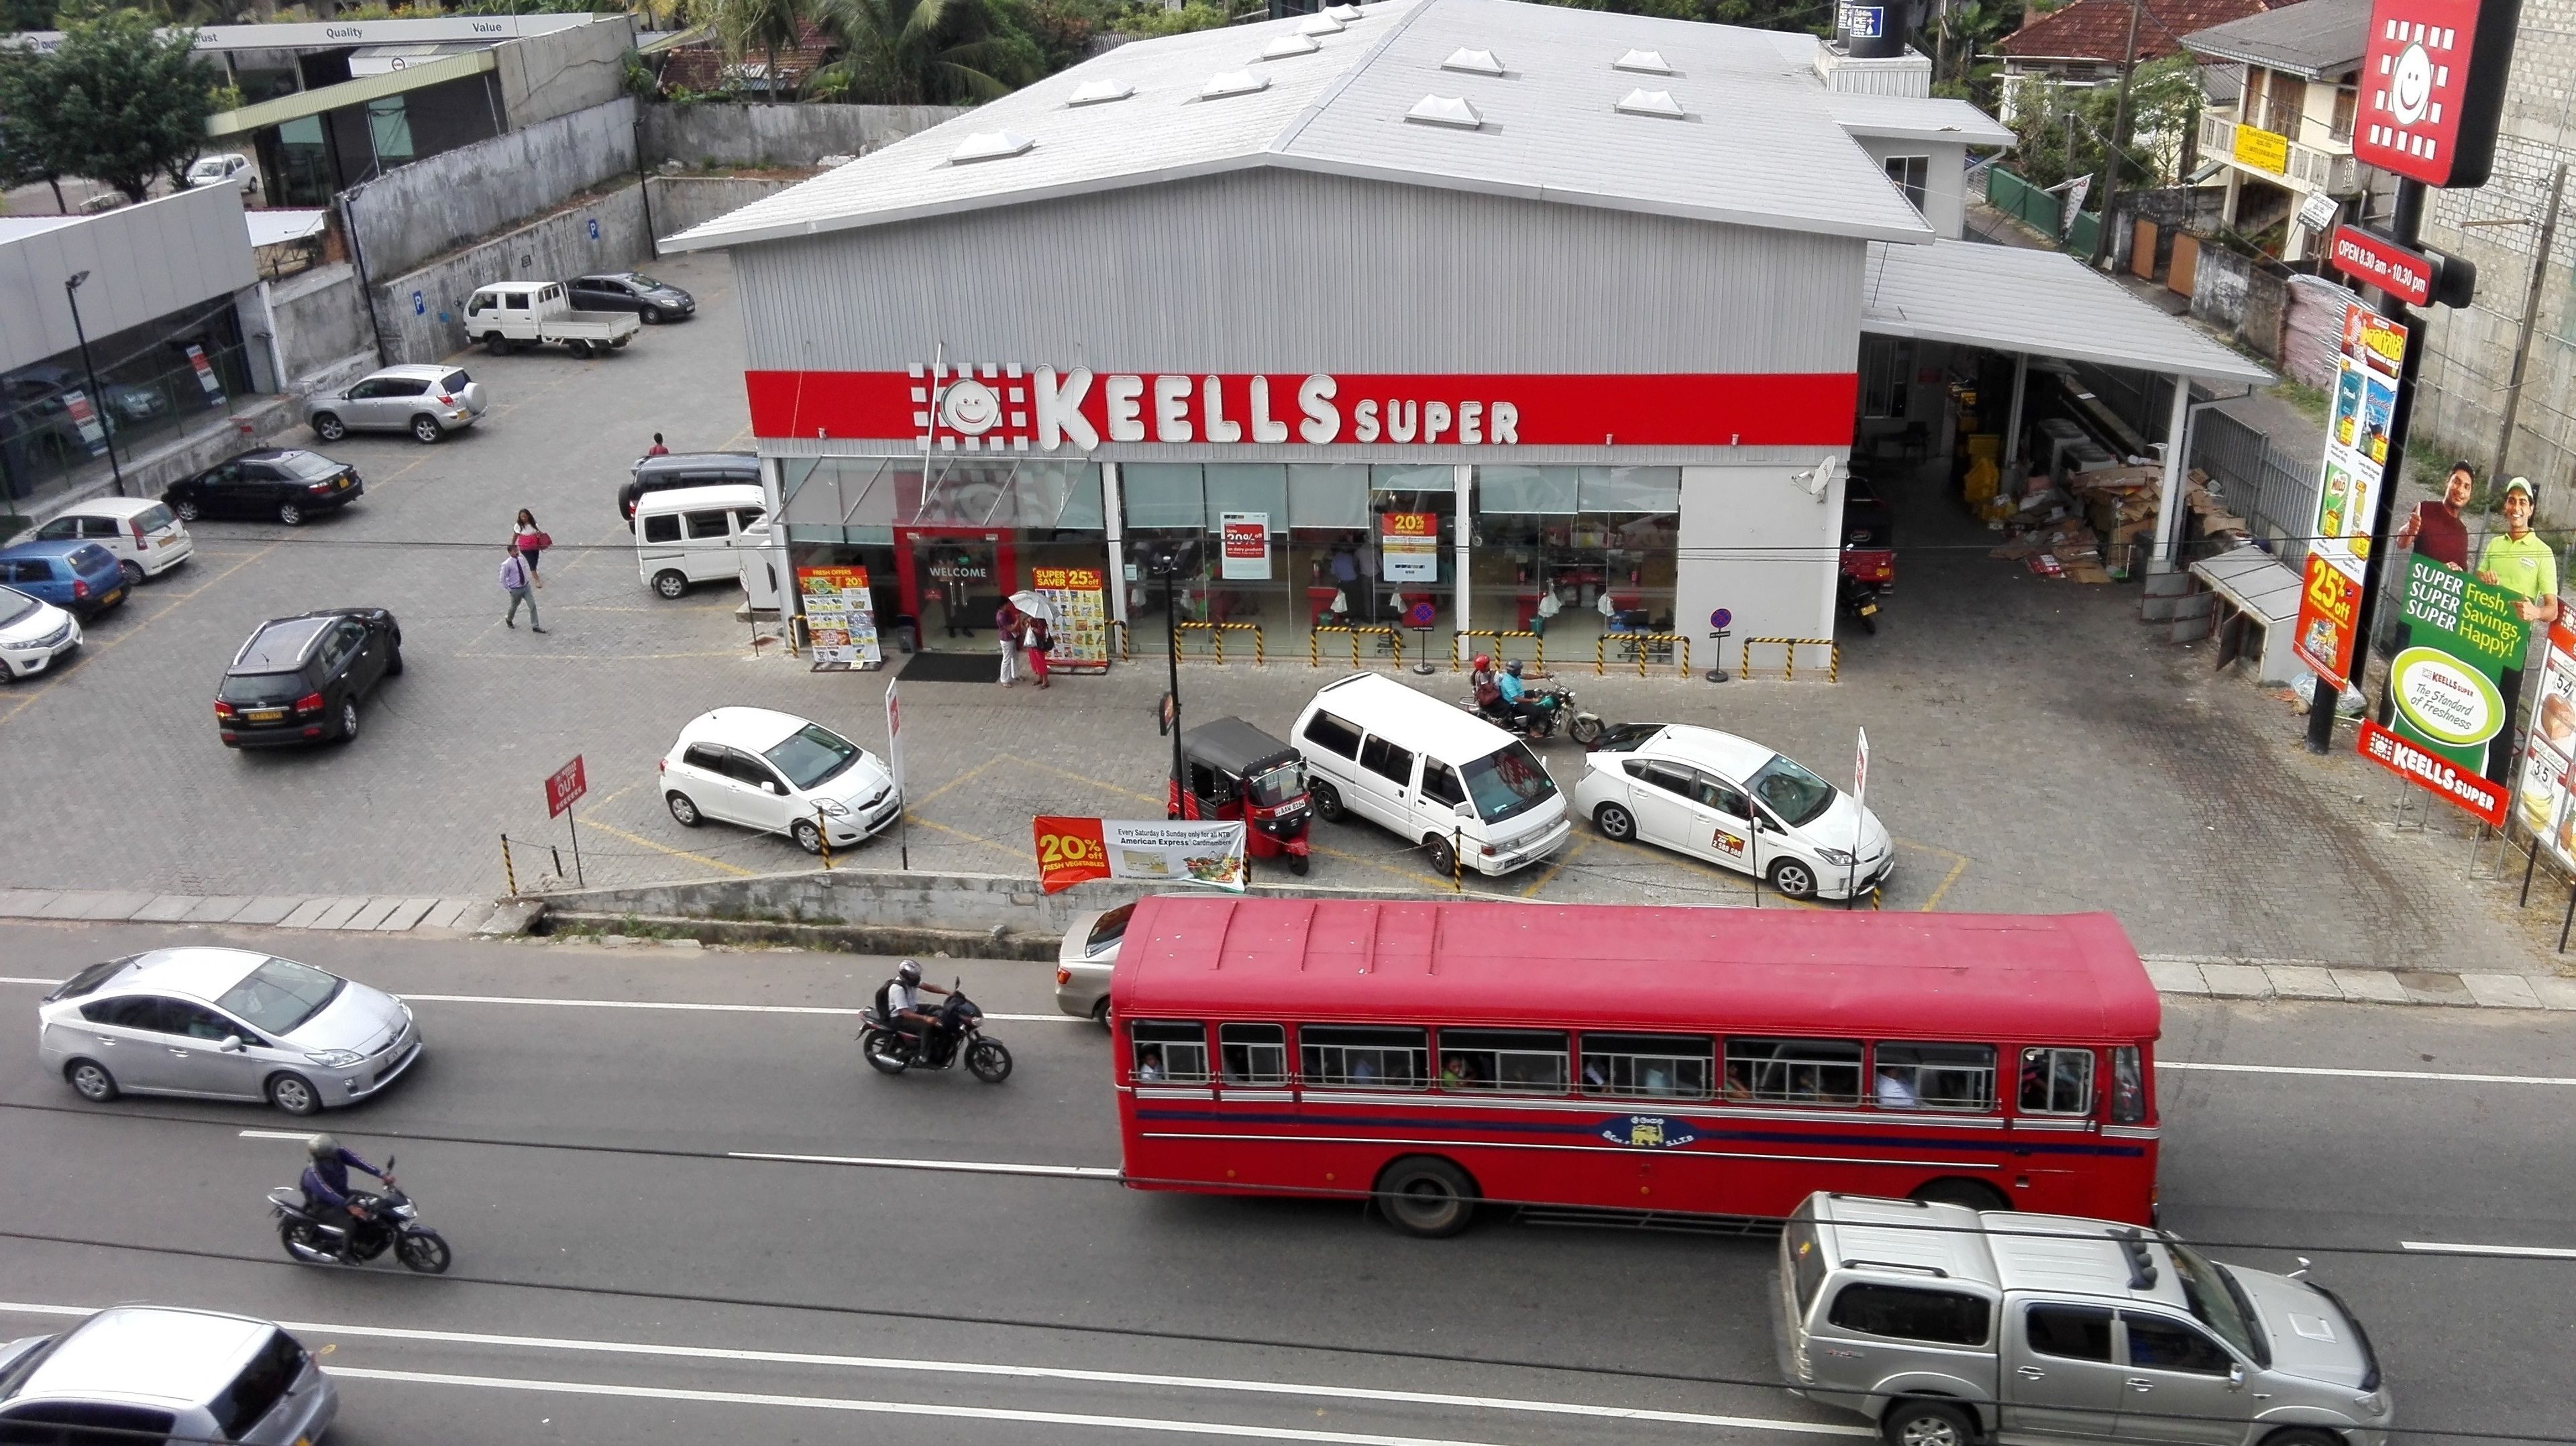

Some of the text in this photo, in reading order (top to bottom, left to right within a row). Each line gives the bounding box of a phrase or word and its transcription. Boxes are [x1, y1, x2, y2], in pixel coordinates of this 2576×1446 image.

[326, 27, 362, 38] Quality
[472, 22, 502, 32] Value
[2339, 239, 2359, 262] OPEN
[2359, 248, 2375, 269] 8.30
[2375, 259, 2387, 275] am
[2392, 264, 2412, 286] 10.30
[2411, 276, 2426, 293] pm
[1033, 364, 1519, 452] KEELLS SUPER
[1395, 515, 1424, 529] 20%
[1226, 533, 1256, 545] 20%
[929, 567, 987, 577] WELCOME
[1036, 570, 1065, 578] SUPER
[1037, 578, 1065, 587] SAVER
[1069, 570, 1093, 585] 25%
[2310, 559, 2347, 608] 25%
[2413, 563, 2508, 616] SUPER Fresh,
[2334, 601, 2350, 620] off
[2410, 581, 2521, 643] SUPER Savings,
[2407, 599, 2514, 658] SUPER Happy!
[2432, 671, 2473, 697] KEELLS SUPER
[2416, 683, 2474, 716] The Standard
[2410, 696, 2472, 730] of Freshness
[2393, 742, 2495, 812] KEELLS SUPER
[2534, 760, 2549, 783] 35
[557, 773, 576, 797] OUT
[1118, 828, 1134, 837] Every
[1135, 829, 1159, 838] Saturday
[1166, 830, 1187, 838] Sunday
[1187, 830, 1200, 838] only
[1040, 834, 1101, 863] 20%
[1088, 852, 1103, 860] off
[1718, 842, 1729, 852] 588
[1730, 848, 1741, 857] 588
[1043, 862, 1064, 872] FRESH
